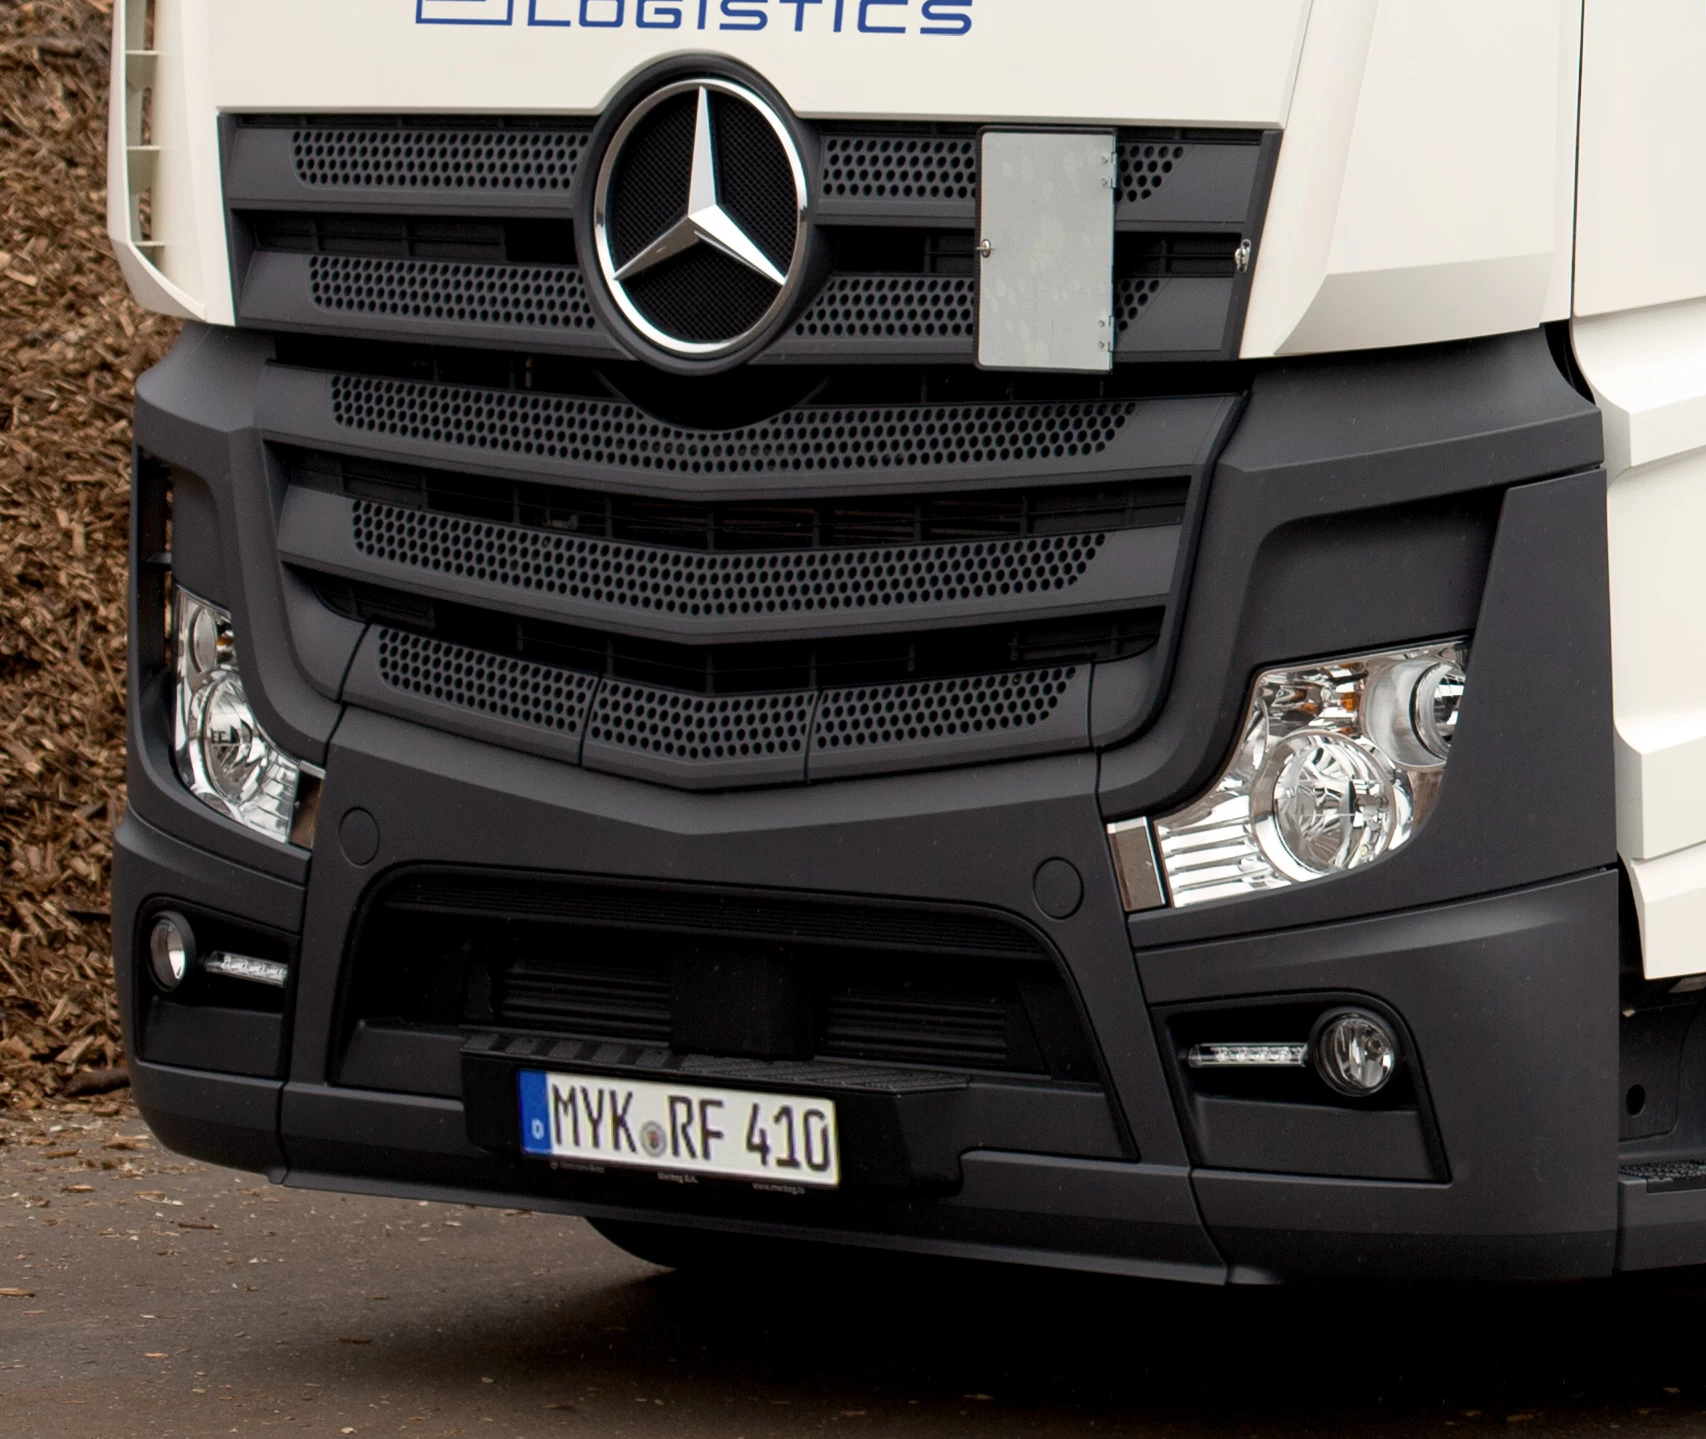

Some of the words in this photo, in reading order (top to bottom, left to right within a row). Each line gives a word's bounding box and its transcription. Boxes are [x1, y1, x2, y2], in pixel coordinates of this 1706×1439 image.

[552, 1084, 637, 1153] MYK
[668, 1095, 724, 1161] RF
[745, 1102, 832, 1172] 410
